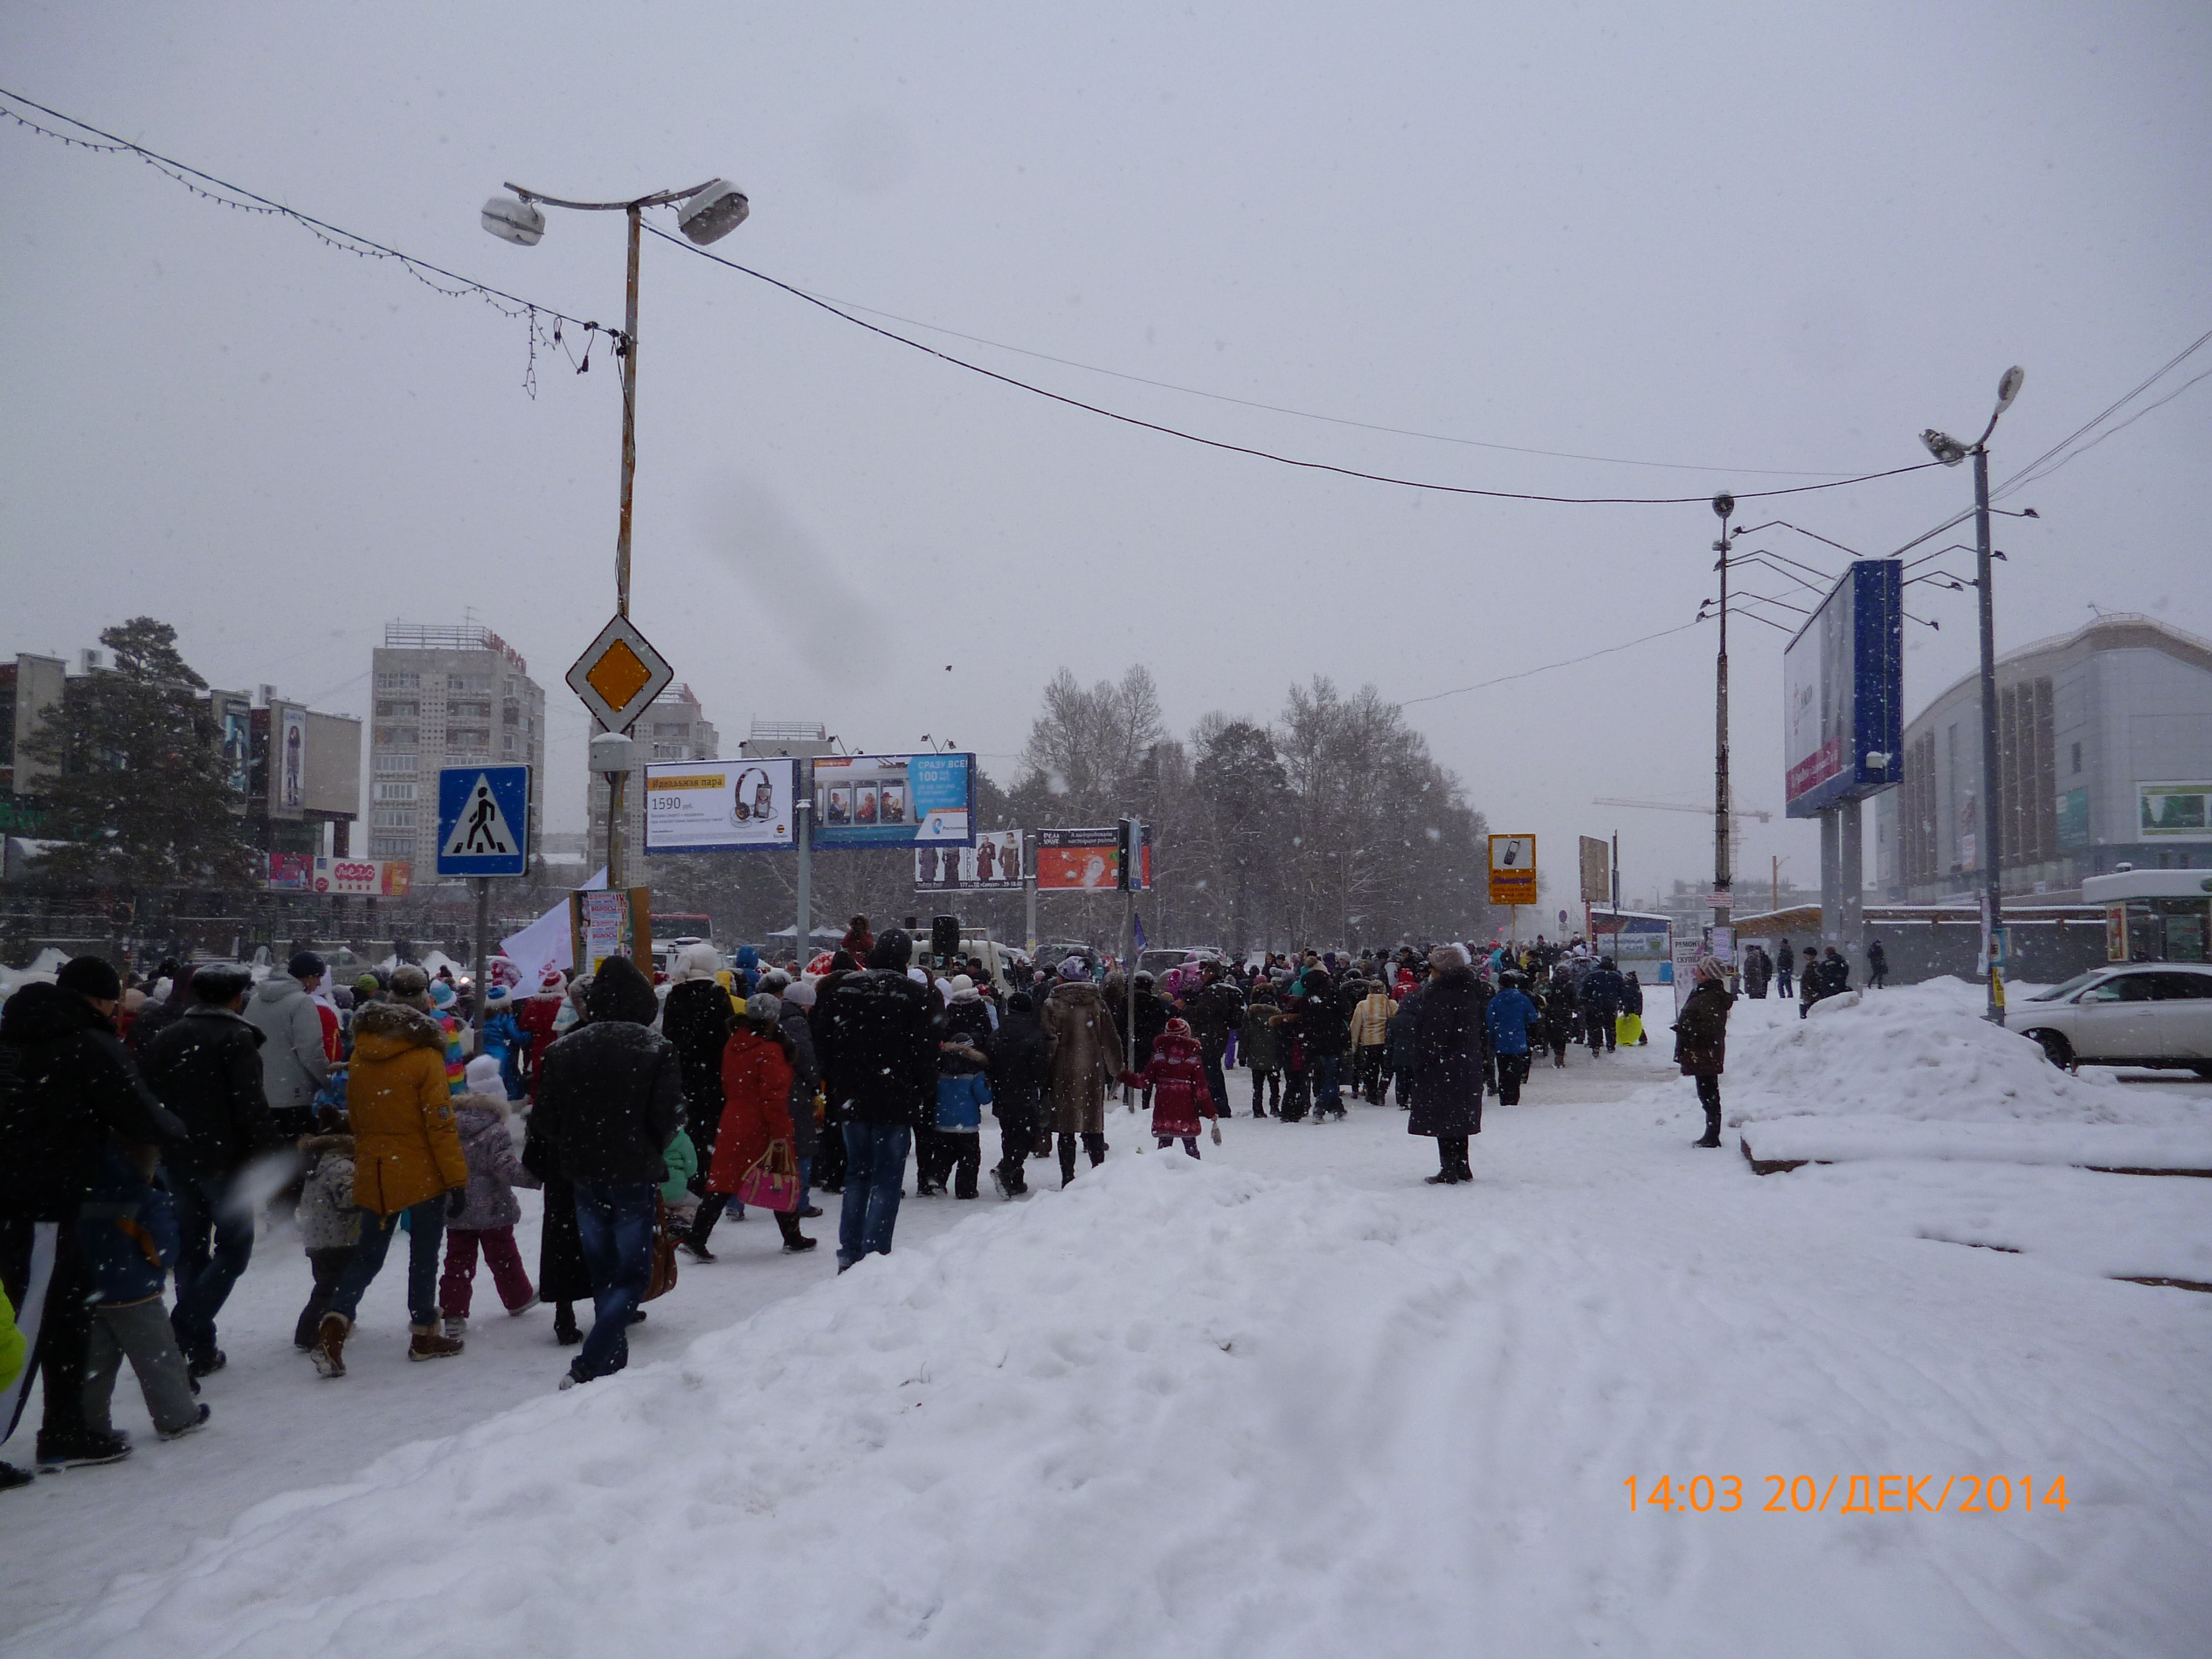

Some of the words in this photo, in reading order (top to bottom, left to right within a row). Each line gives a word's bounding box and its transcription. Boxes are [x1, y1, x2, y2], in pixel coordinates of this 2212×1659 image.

[919, 761, 946, 769] СРАЗУ
[919, 771, 938, 781] 100
[653, 779, 699, 789] Идеальная
[702, 779, 722, 788] пара
[653, 797, 681, 810] 1590
